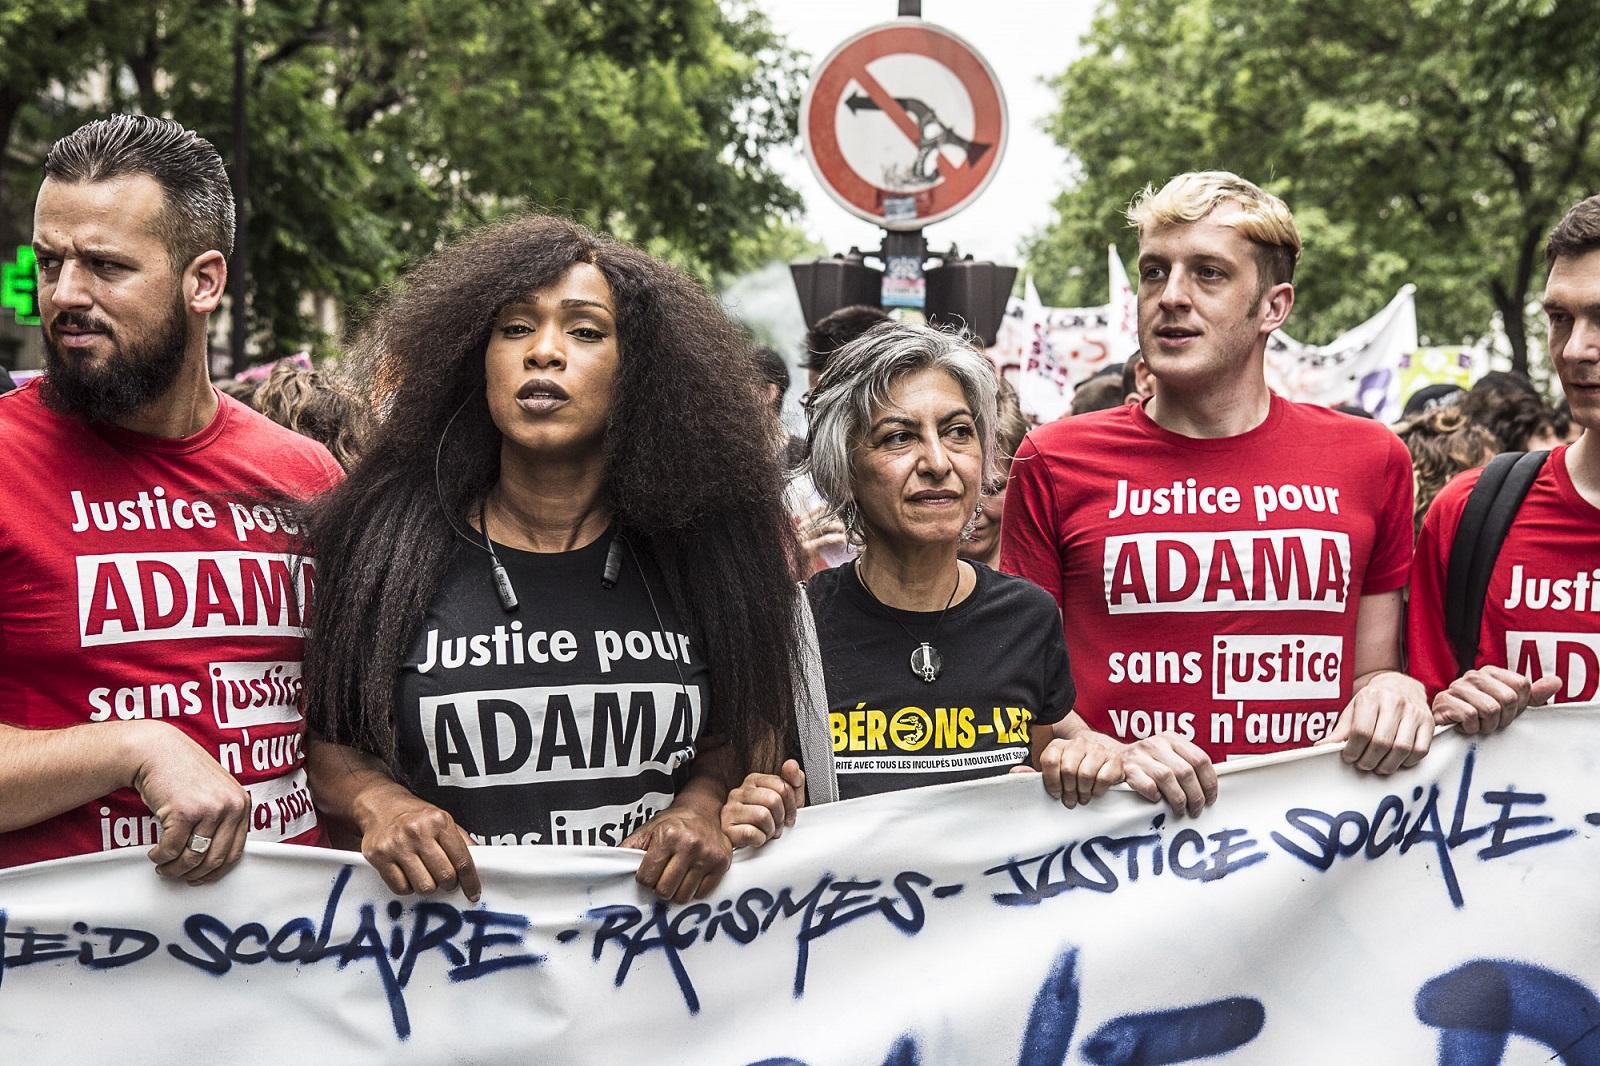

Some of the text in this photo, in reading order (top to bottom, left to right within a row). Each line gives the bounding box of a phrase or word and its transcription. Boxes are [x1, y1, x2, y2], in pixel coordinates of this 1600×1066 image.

[71, 486, 217, 532] Justice
[1108, 478, 1339, 521] Justice pour
[1110, 536, 1343, 605] ADAMA
[1504, 565, 1600, 612] Justi
[418, 620, 690, 673] Justice pour
[1108, 640, 1340, 694] sans justice
[88, 680, 203, 722] sans
[434, 691, 695, 777] ADAMA
[1108, 710, 1195, 741] vous
[854, 760, 874, 769] AVEC
[876, 760, 896, 769] TOUS
[898, 760, 911, 769] LES
[912, 758, 950, 769] INCULPÉS
[951, 758, 963, 767] DU
[964, 752, 1012, 766] MOUVEMENT
